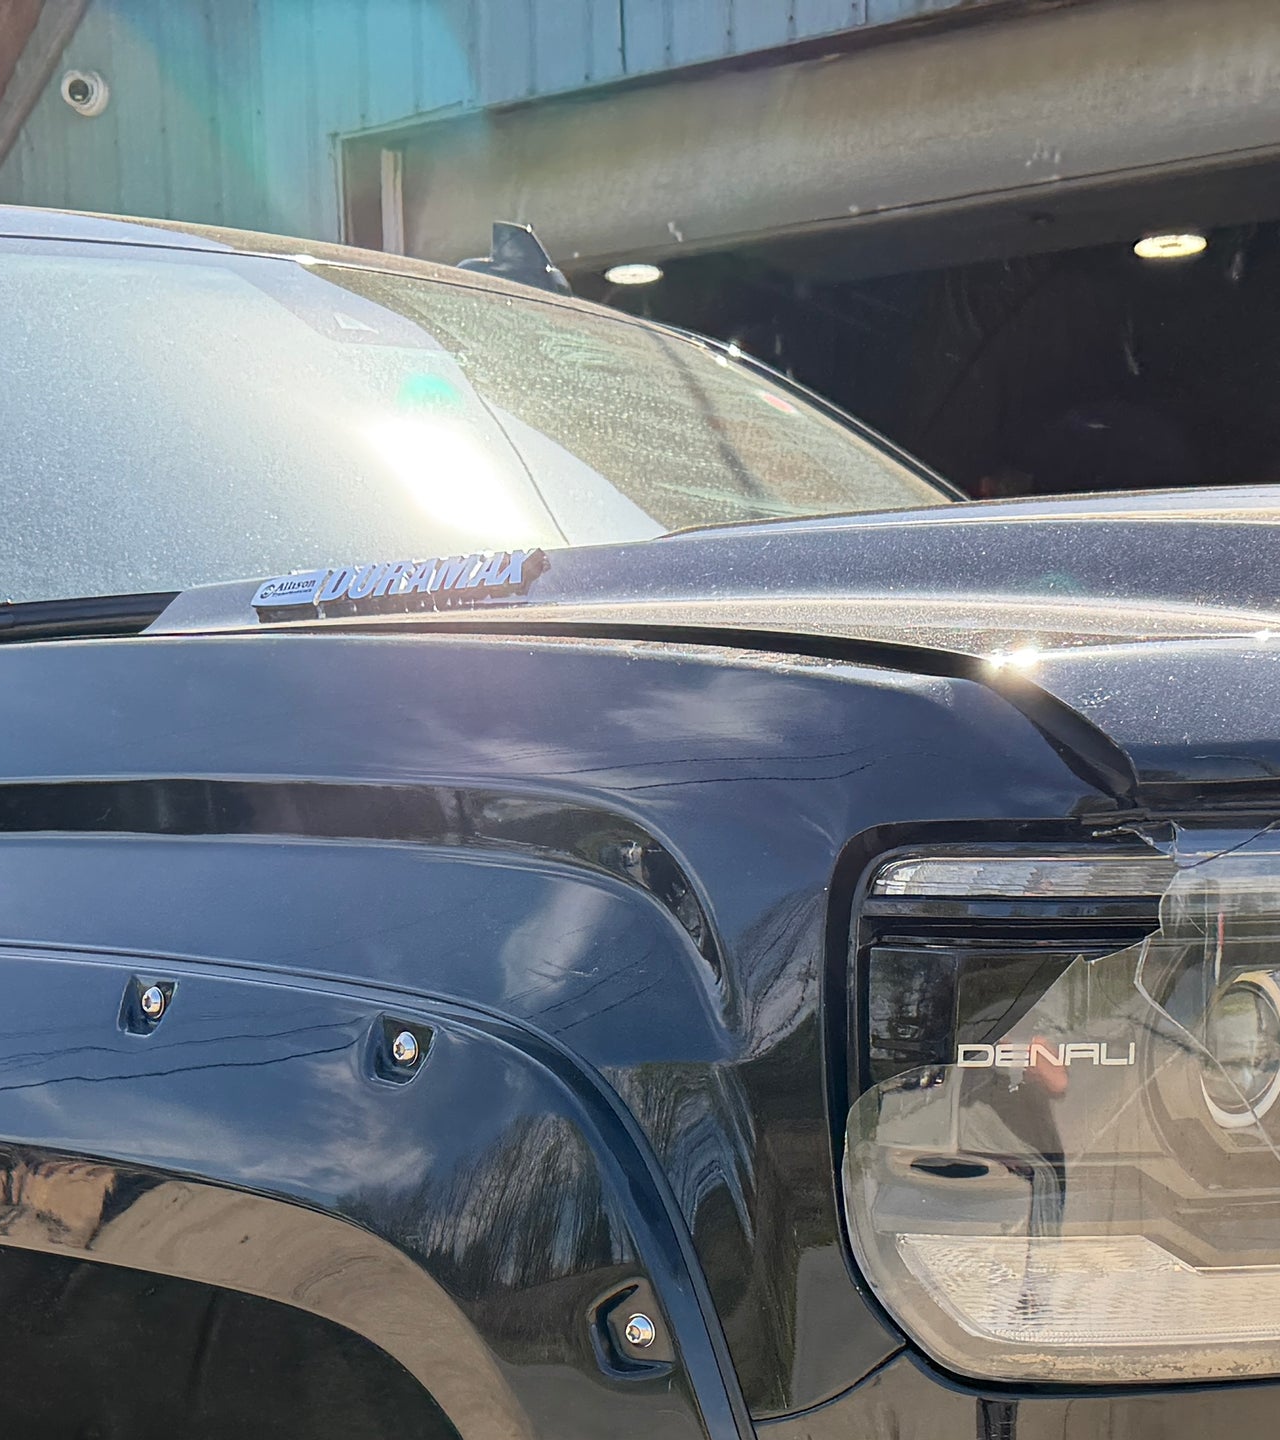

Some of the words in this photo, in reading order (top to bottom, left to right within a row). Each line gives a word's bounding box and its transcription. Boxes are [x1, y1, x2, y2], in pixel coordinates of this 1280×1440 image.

[273, 579, 316, 592] Allison
[320, 548, 541, 601] DURAMAX
[957, 1042, 1136, 1068] DENALI
